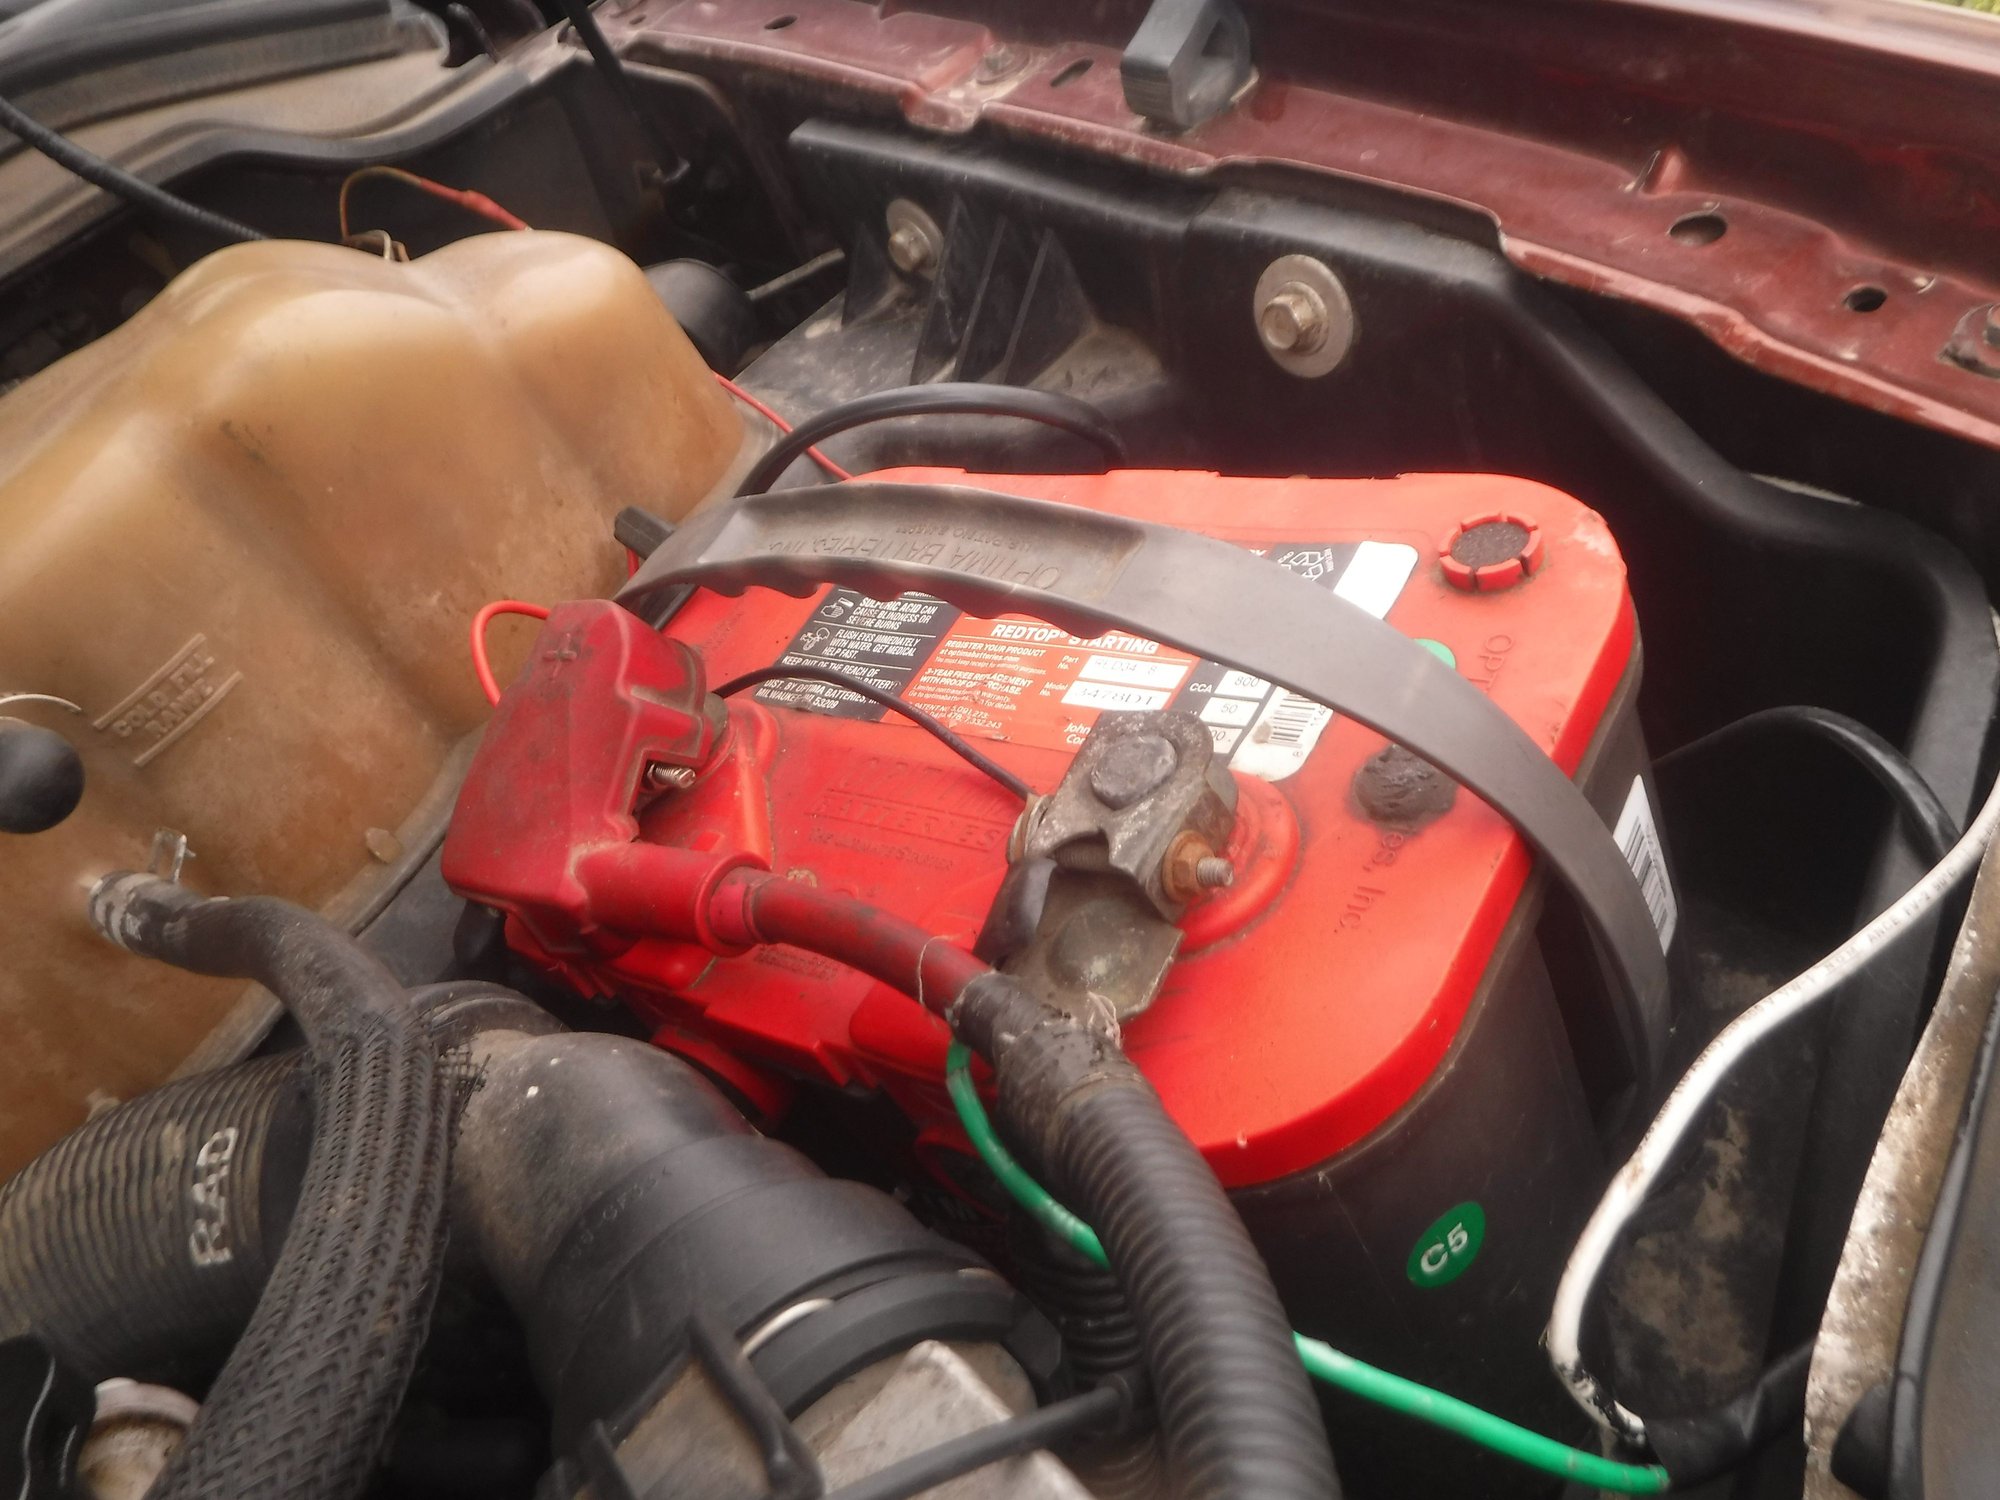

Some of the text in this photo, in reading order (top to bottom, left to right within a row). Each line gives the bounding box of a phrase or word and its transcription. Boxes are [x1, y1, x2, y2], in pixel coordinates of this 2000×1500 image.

[950, 547, 1060, 590] OPTIMA
[853, 606, 932, 624] CAUSE BLINDNESS OR
[899, 602, 922, 614] ACID
[920, 605, 938, 615] CAN
[846, 615, 902, 630] SEVERE BURNS
[835, 629, 921, 648] FLUSH EYES IMMEDIATELY
[822, 646, 859, 659] HELP FAST.
[829, 637, 849, 648] WITH
[872, 643, 890, 654] GET
[886, 645, 917, 657] MEDICAL
[945, 640, 1046, 657] REGISTER YOUR PRODUCT
[781, 655, 803, 666] KEEP
[842, 663, 869, 677] REACH
[866, 668, 881, 677] OF
[1057, 662, 1070, 670] No.
[1062, 655, 1080, 664] Part
[1469, 633, 1514, 692] OPT
[953, 670, 975, 680] FREE
[784, 682, 797, 691] BY
[796, 683, 826, 695] OPTIMA
[919, 675, 1023, 695] WITH PROOF OF RCHASE.
[1044, 681, 1069, 691] Model
[1190, 682, 1213, 693] CCA
[1234, 676, 1260, 688] 800
[813, 697, 840, 709] 53209
[1221, 703, 1239, 714] 50
[1064, 723, 1091, 734] John
[188, 1126, 240, 1267] RAD
[1420, 1221, 1469, 1274] C5
